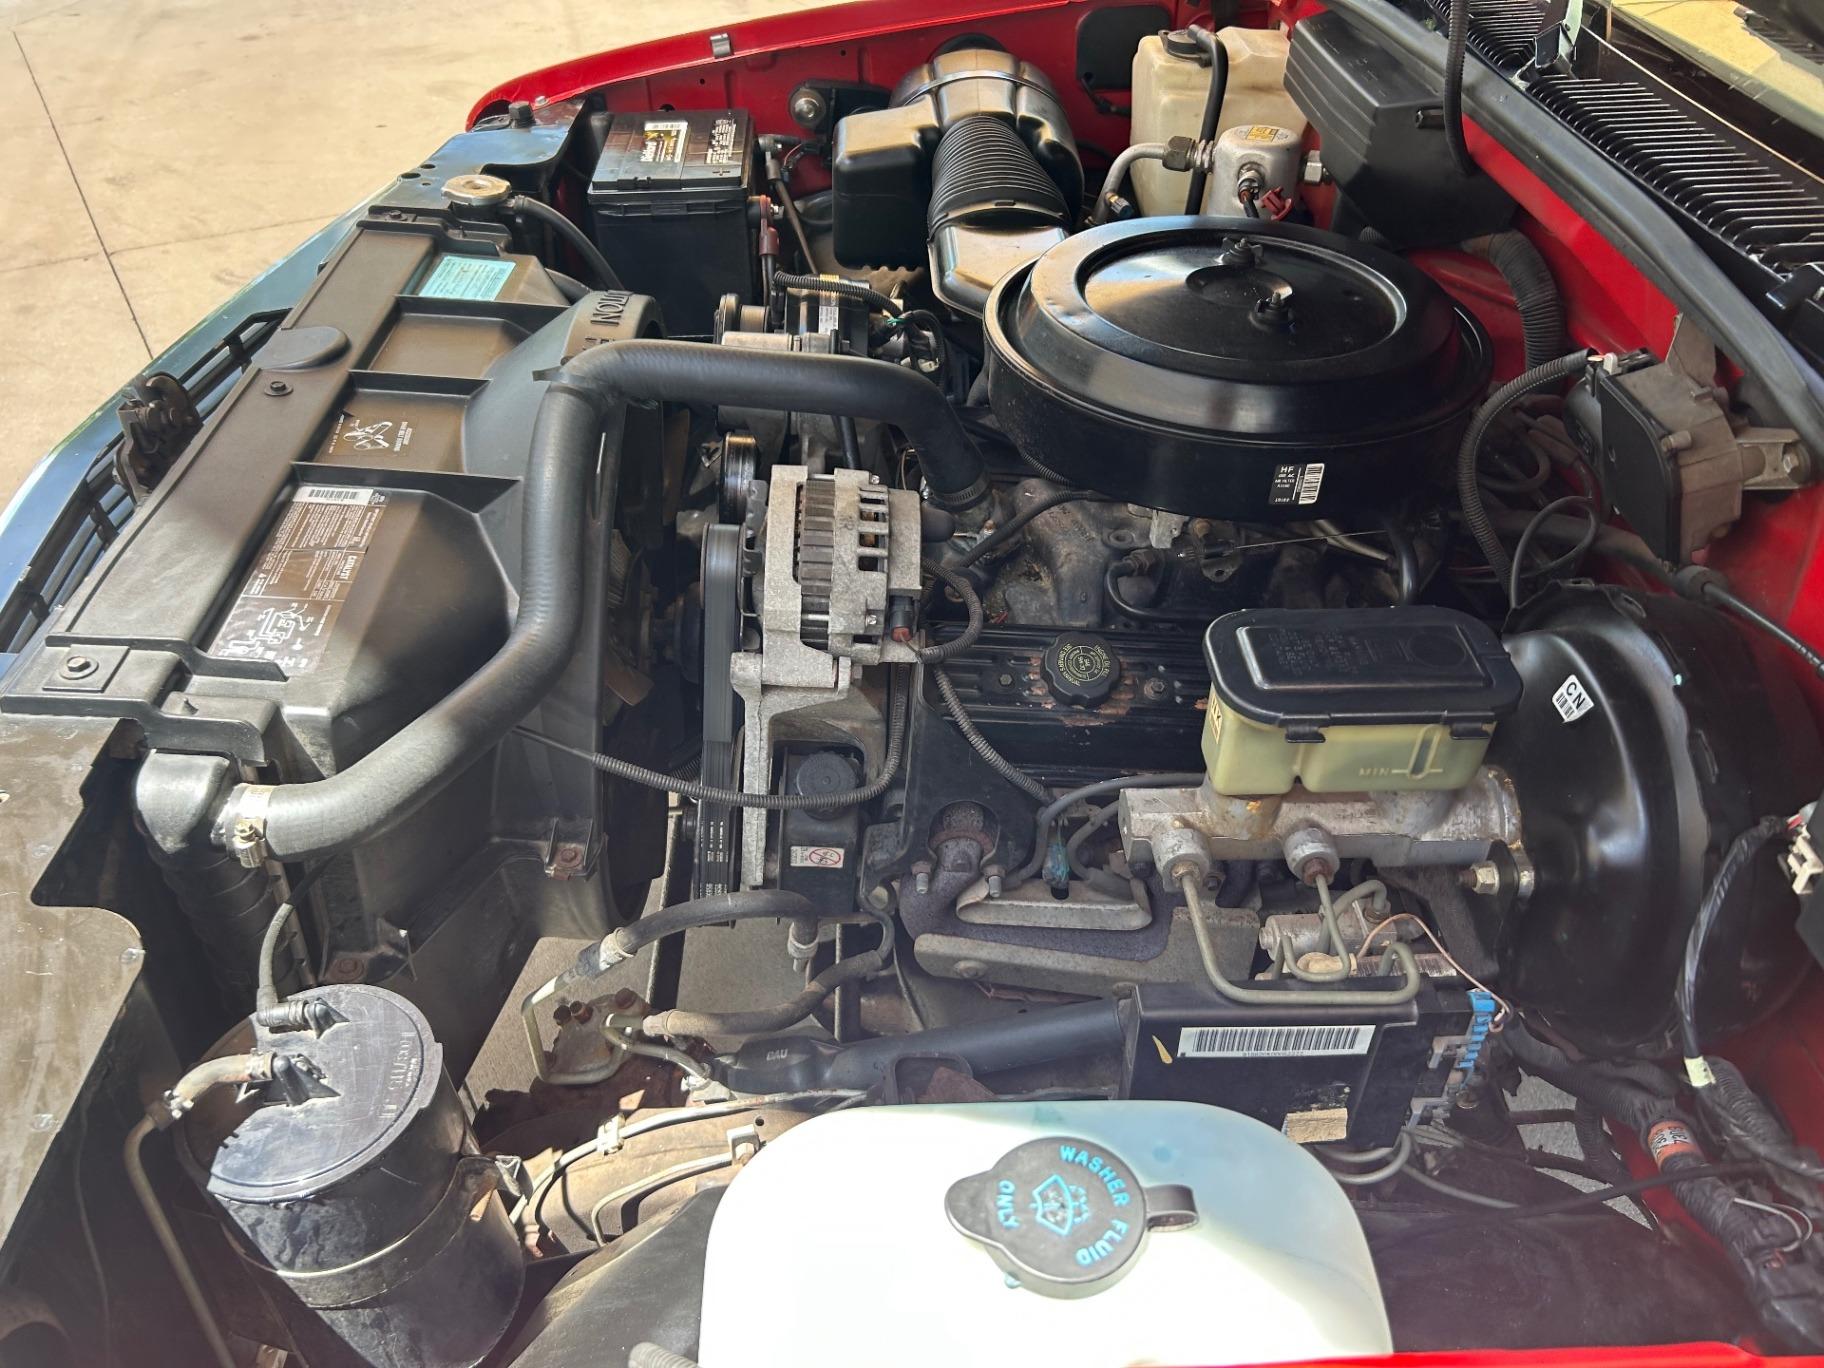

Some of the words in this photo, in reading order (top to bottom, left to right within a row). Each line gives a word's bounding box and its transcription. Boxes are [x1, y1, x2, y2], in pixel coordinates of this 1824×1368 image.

[1280, 465, 1295, 473] HF
[1566, 681, 1586, 710] CN
[1059, 1145, 1131, 1207] WASHER
[997, 1180, 1020, 1229] ONLY
[1075, 1219, 1129, 1267] FLUID
